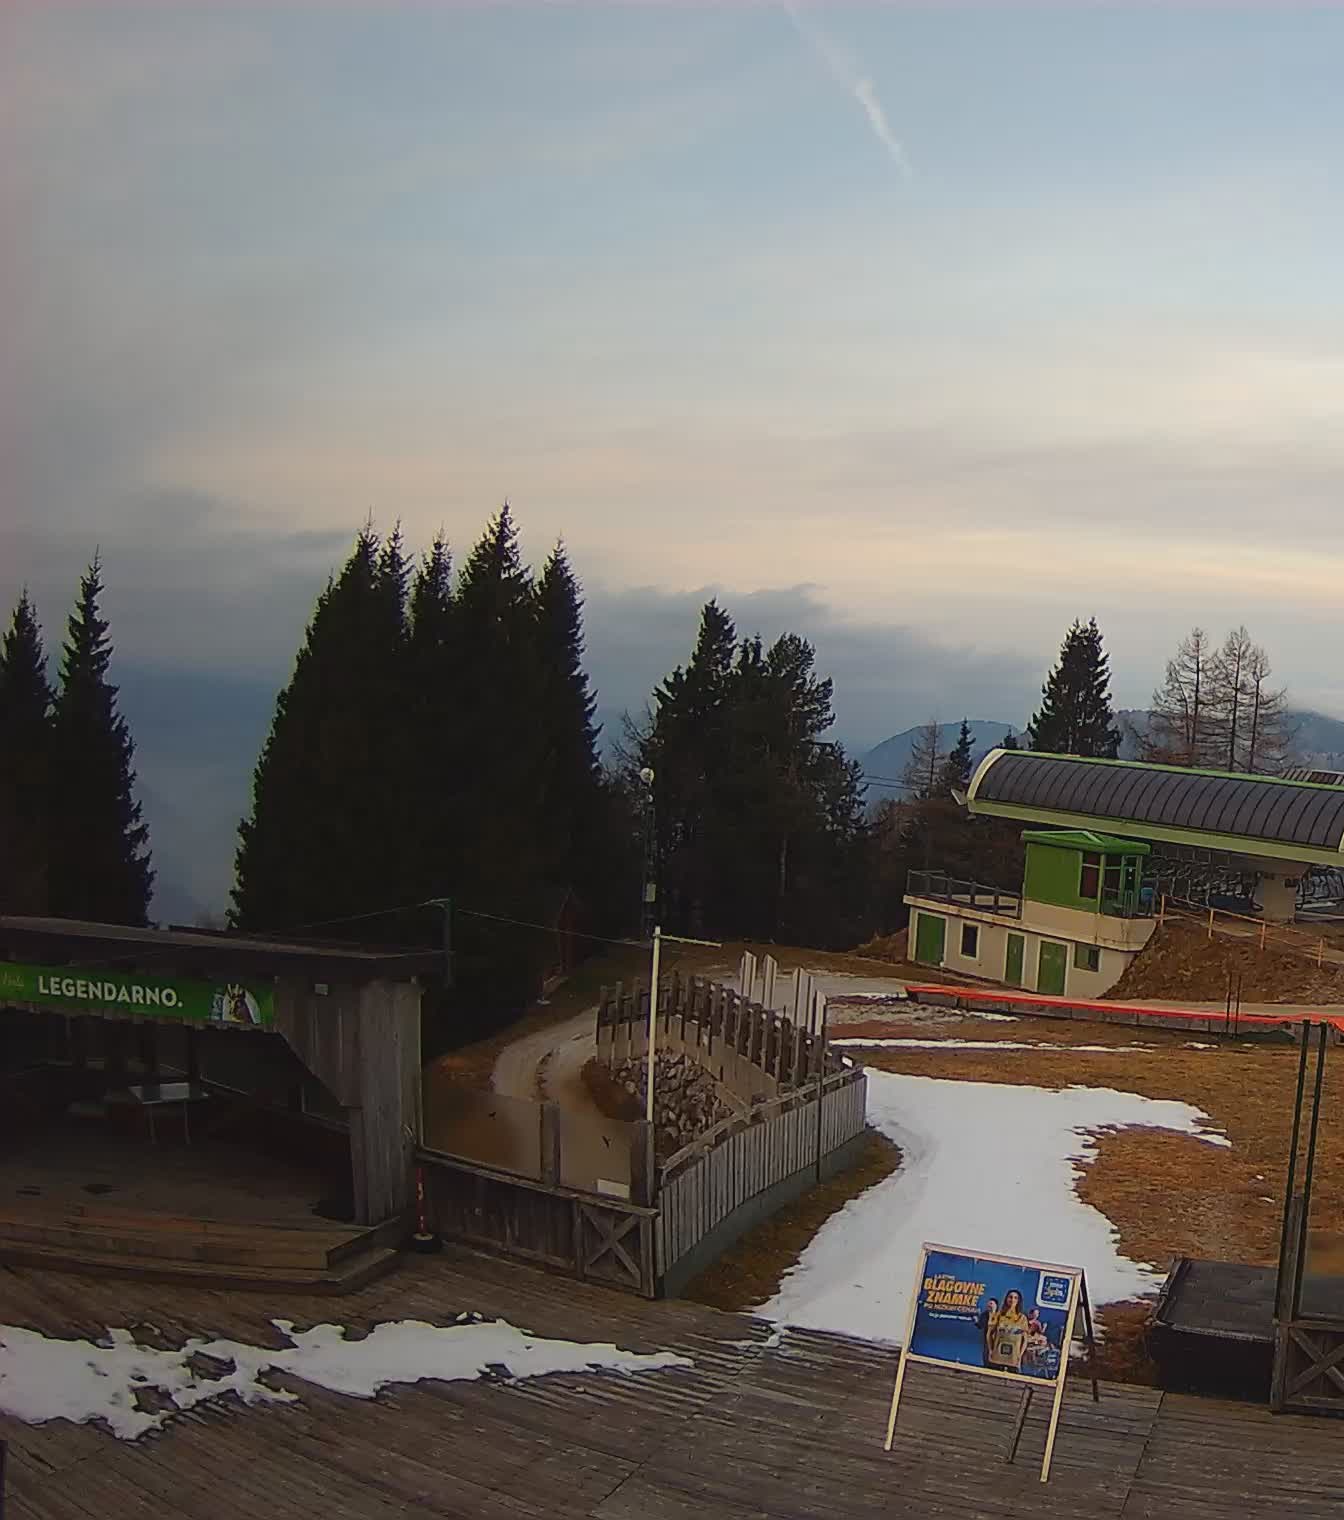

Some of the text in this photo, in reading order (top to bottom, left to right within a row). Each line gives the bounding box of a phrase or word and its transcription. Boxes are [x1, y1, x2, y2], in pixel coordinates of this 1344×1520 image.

[38, 975, 183, 1007] LEGENDARNO.
[924, 1278, 986, 1295] BLAGOVNE
[926, 1290, 979, 1306] ZNAMKE
